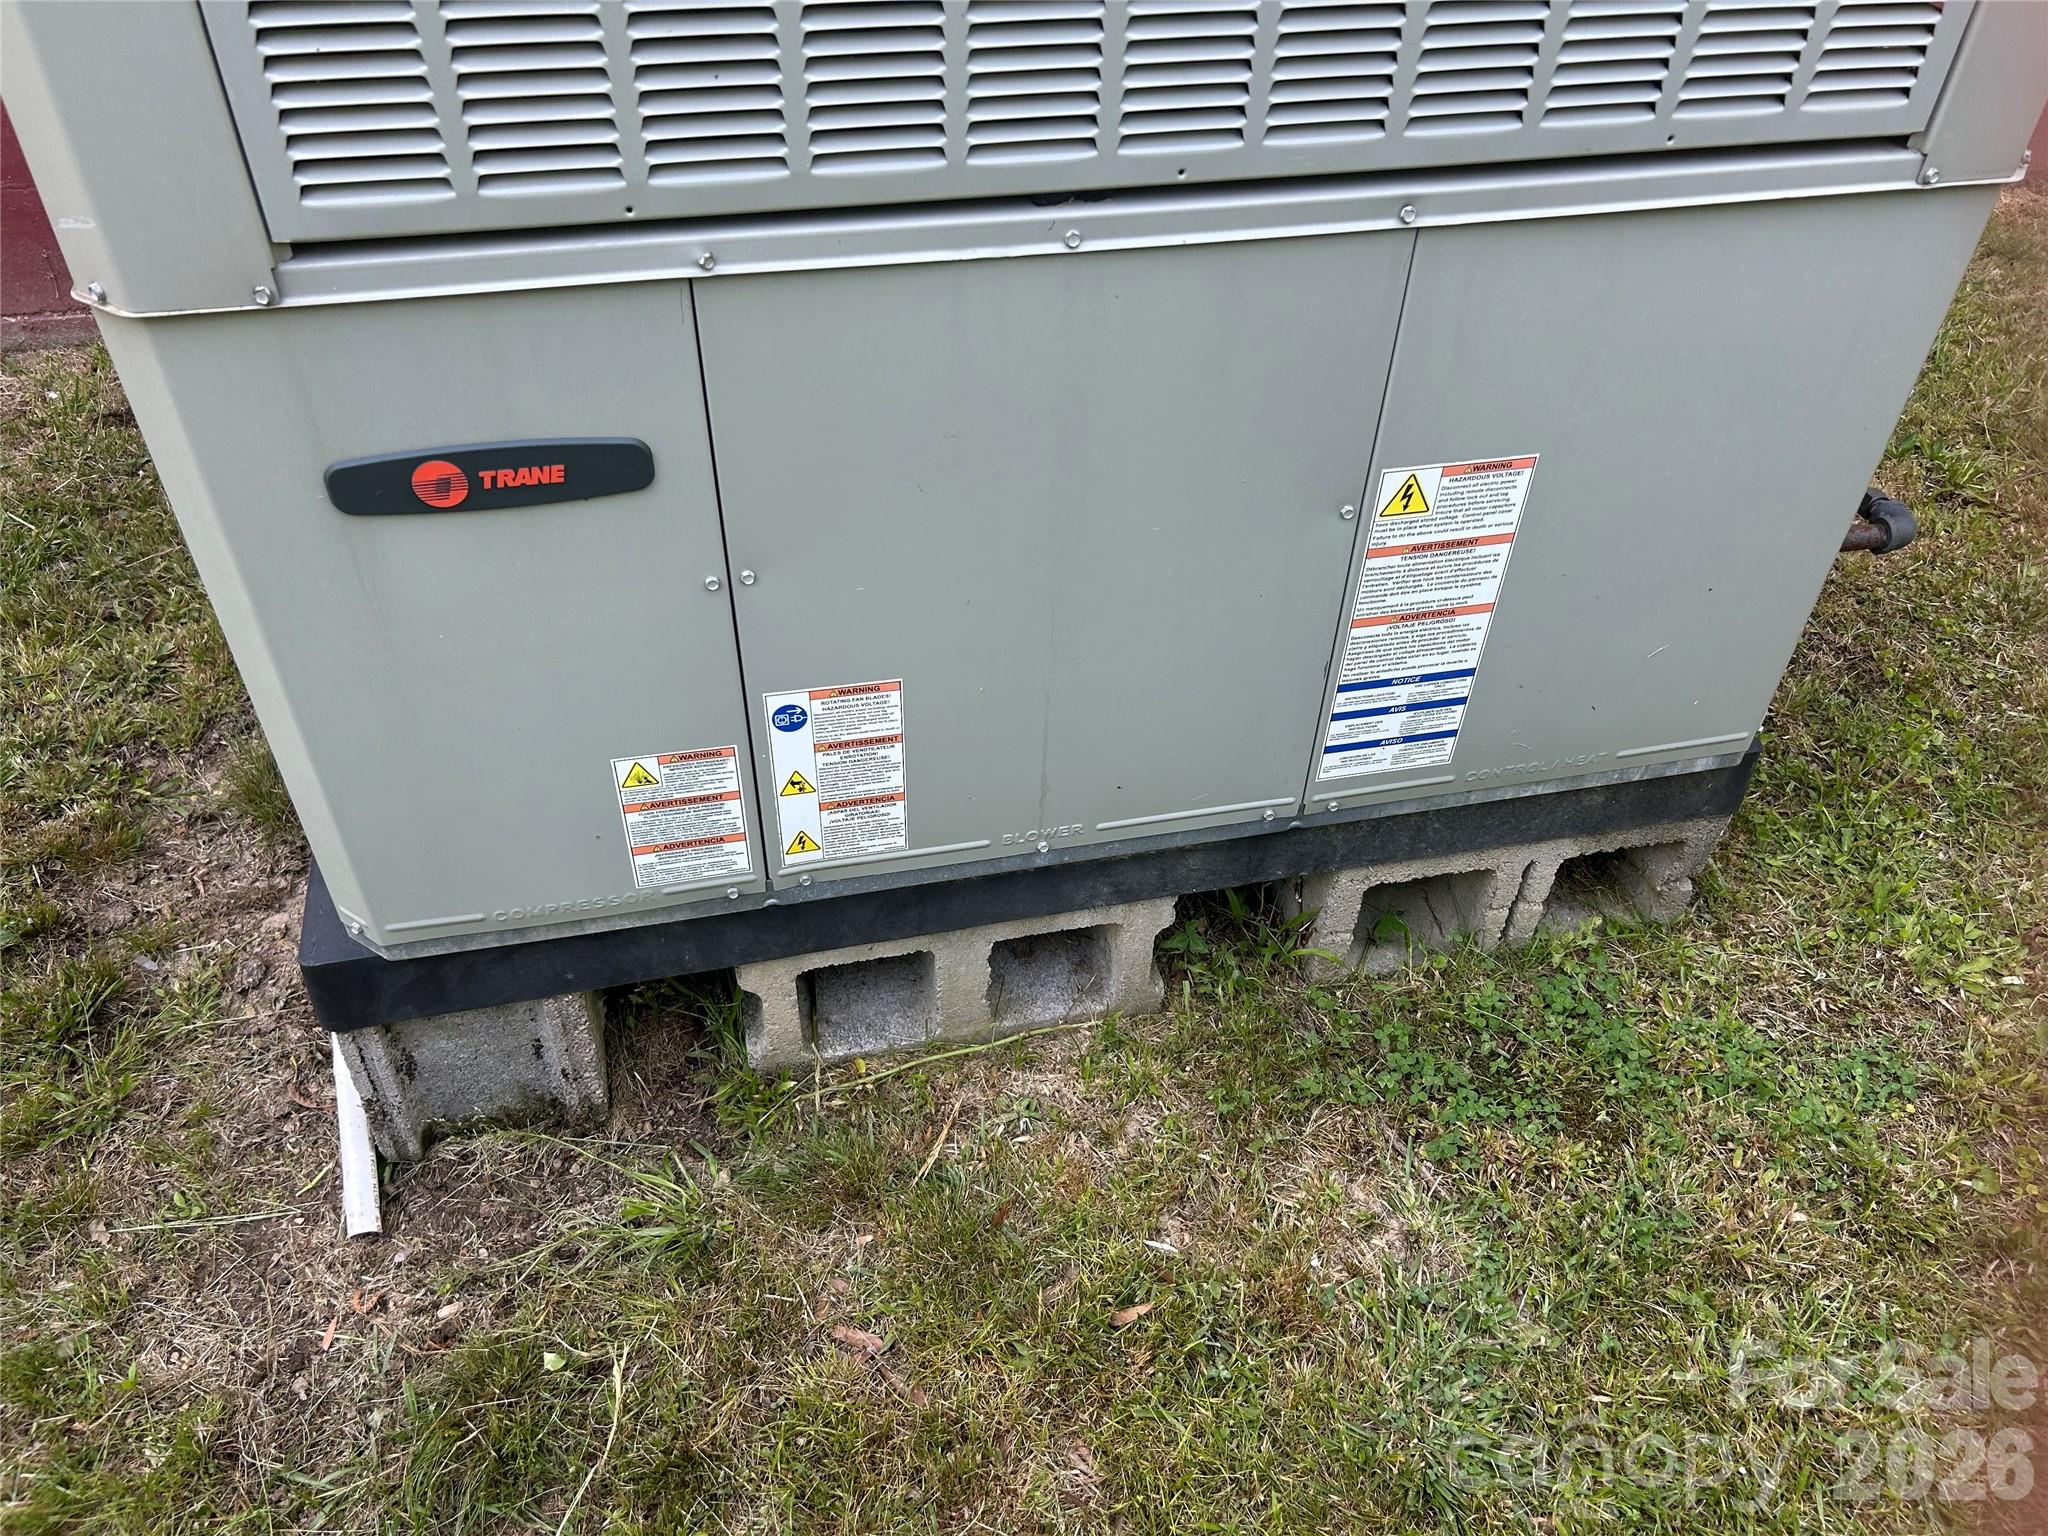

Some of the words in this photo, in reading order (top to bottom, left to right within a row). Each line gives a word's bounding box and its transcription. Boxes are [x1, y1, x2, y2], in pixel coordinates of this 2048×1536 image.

[1473, 462, 1513, 471] WARNING
[478, 464, 566, 490] TRANE
[1449, 474, 1490, 483] HAZARDOUS
[1492, 470, 1524, 478] VOLTAGE!
[1410, 539, 1479, 551] AVERTISSEMENT
[1429, 548, 1476, 558] DANGEREUSE!
[1399, 609, 1456, 621] ADVERTENCIA
[1386, 622, 1416, 630] ¡VOLTAJE
[1417, 618, 1456, 627] PELIGROSO!
[1391, 676, 1421, 685] NOTICE
[838, 685, 880, 695] WARNING
[822, 703, 859, 711] HAZARDOUS
[827, 736, 898, 749] AVERTISSEMENT
[678, 750, 722, 760] WARNING
[848, 755, 890, 763] DANGEREUSE!
[649, 794, 723, 808] AVERTISSEMENT
[836, 795, 895, 807] ADVERTENCIA
[1002, 823, 1084, 847] BLOWER
[663, 837, 725, 850] ADVERTENCIA
[493, 890, 656, 922] COMPRESSOR
